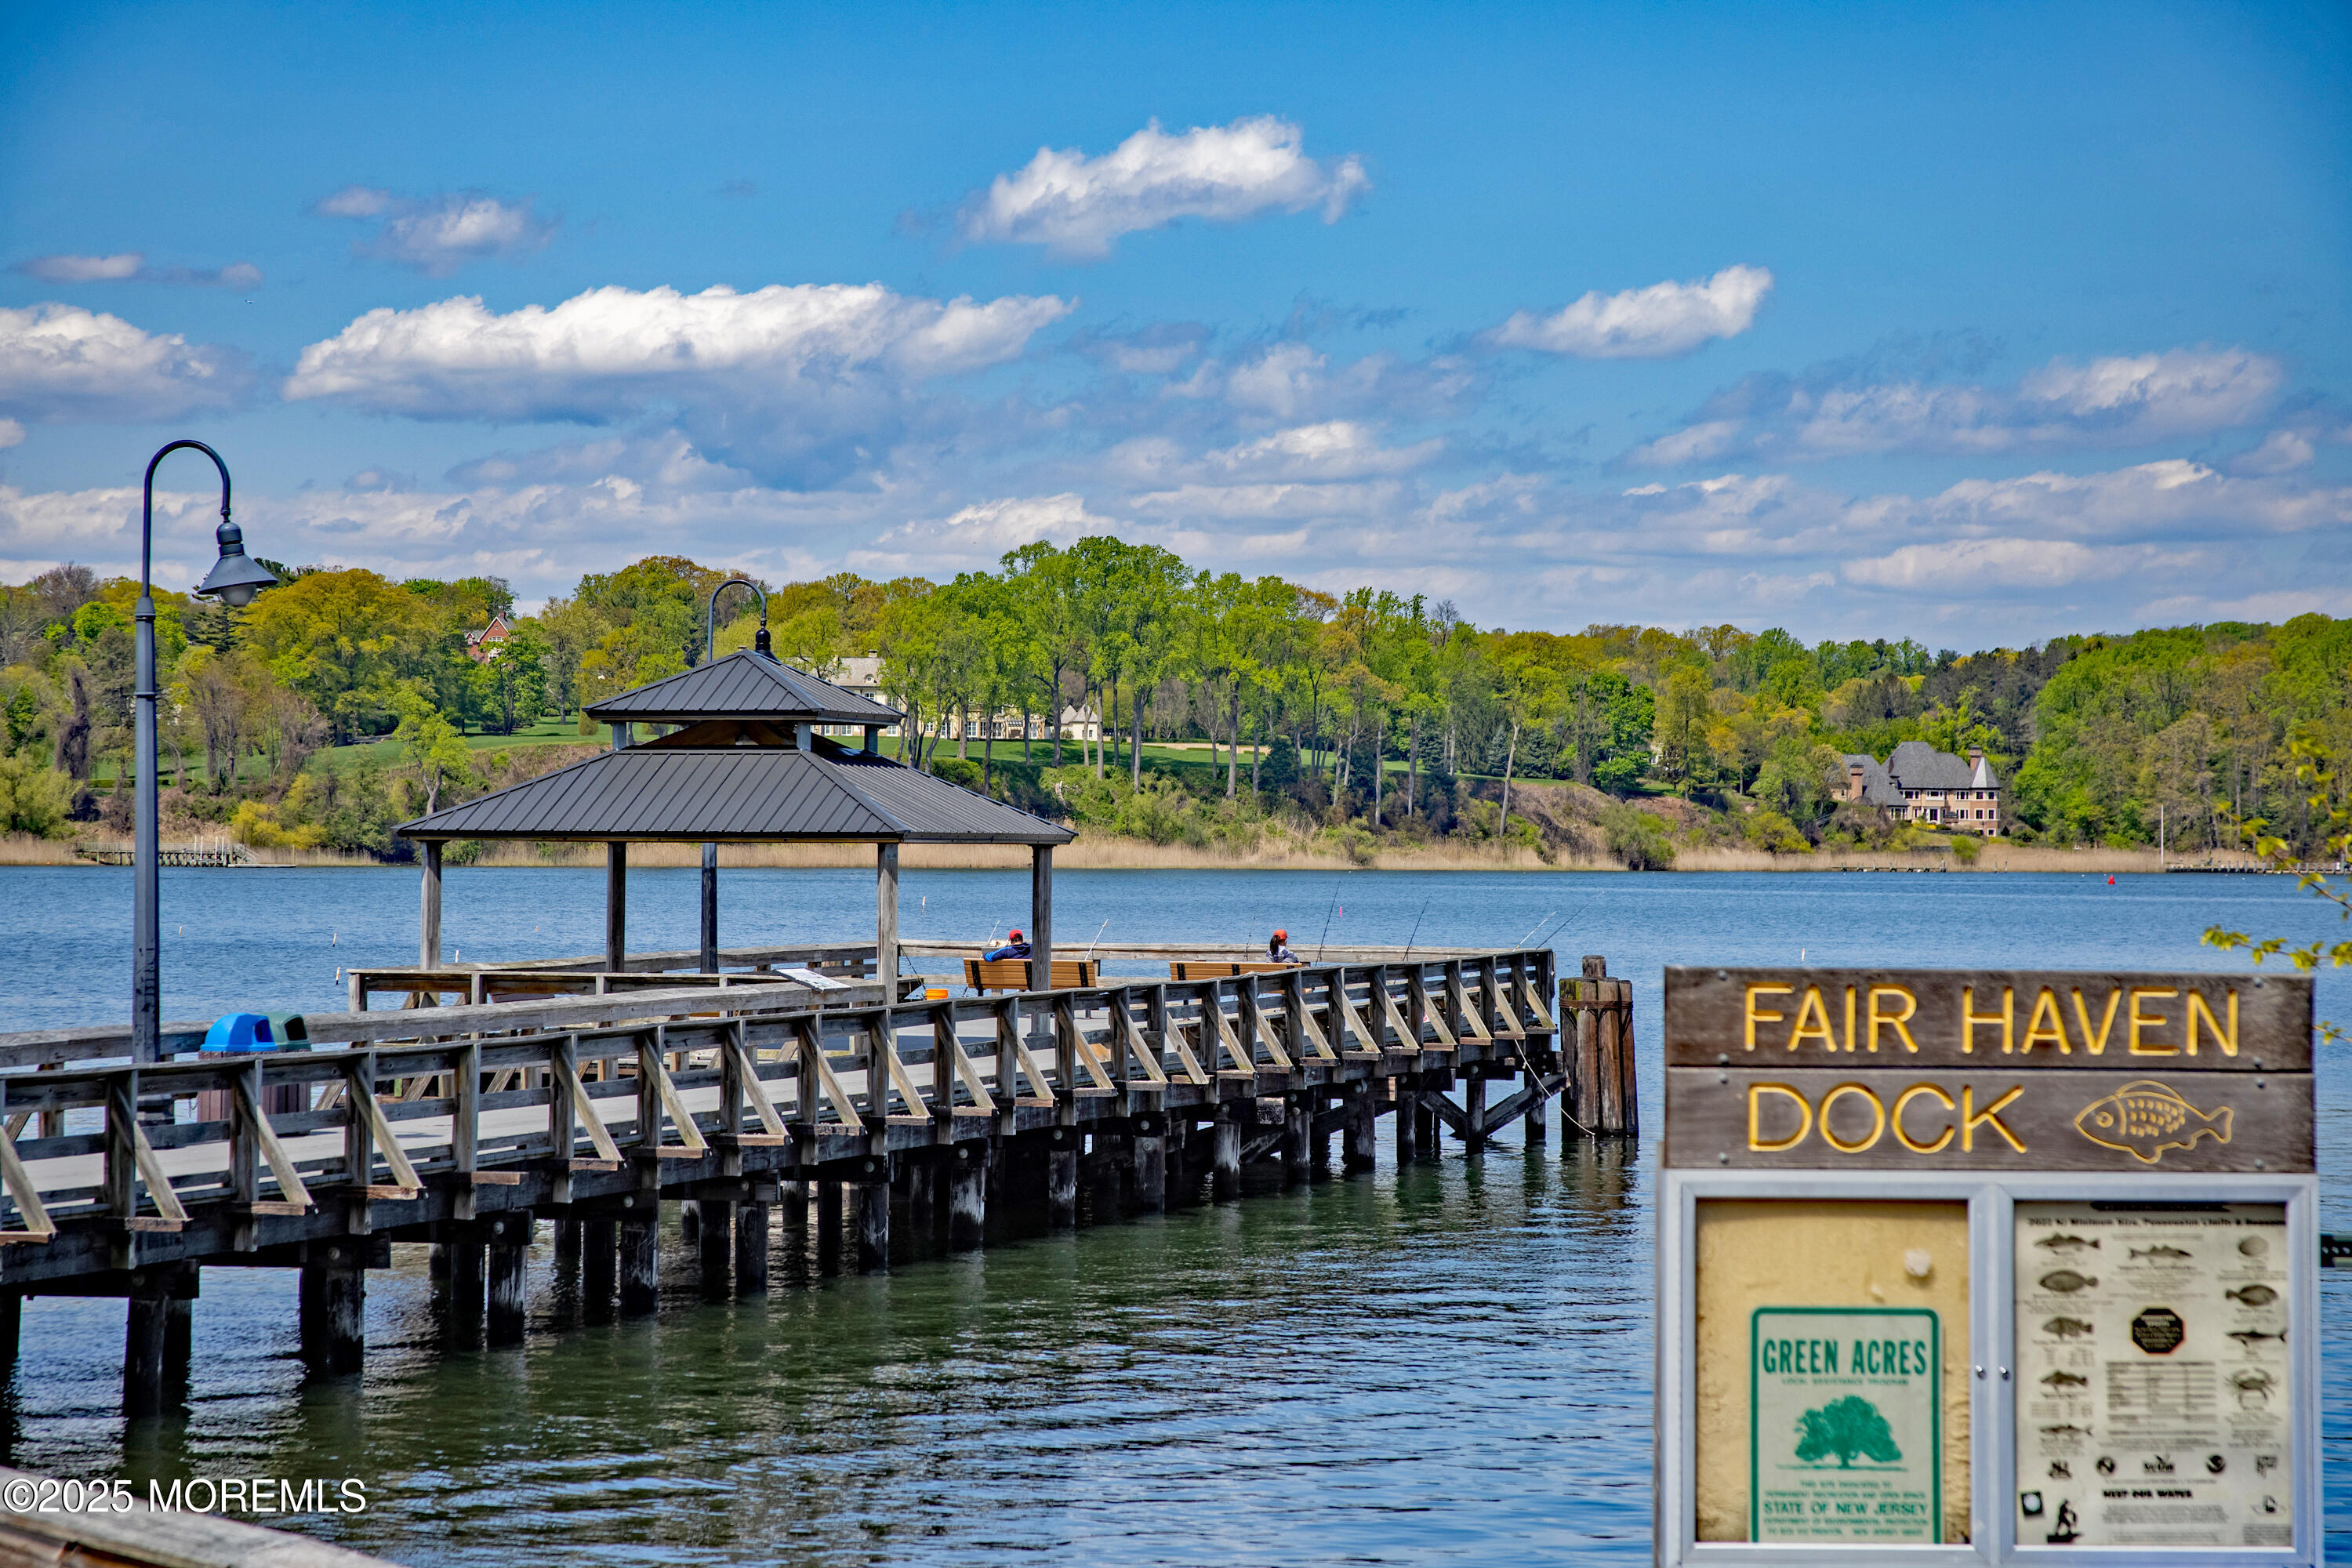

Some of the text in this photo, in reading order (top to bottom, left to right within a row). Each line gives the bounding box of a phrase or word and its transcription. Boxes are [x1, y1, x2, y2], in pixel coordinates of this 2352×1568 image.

[1744, 982, 2240, 1056] FAIR HAVEN
[1748, 1081, 2027, 1154] DOCK
[1762, 1338, 1927, 1376] GREEN ACRES
[1763, 1501, 1929, 1516] STATE OF NEW JERSEY
